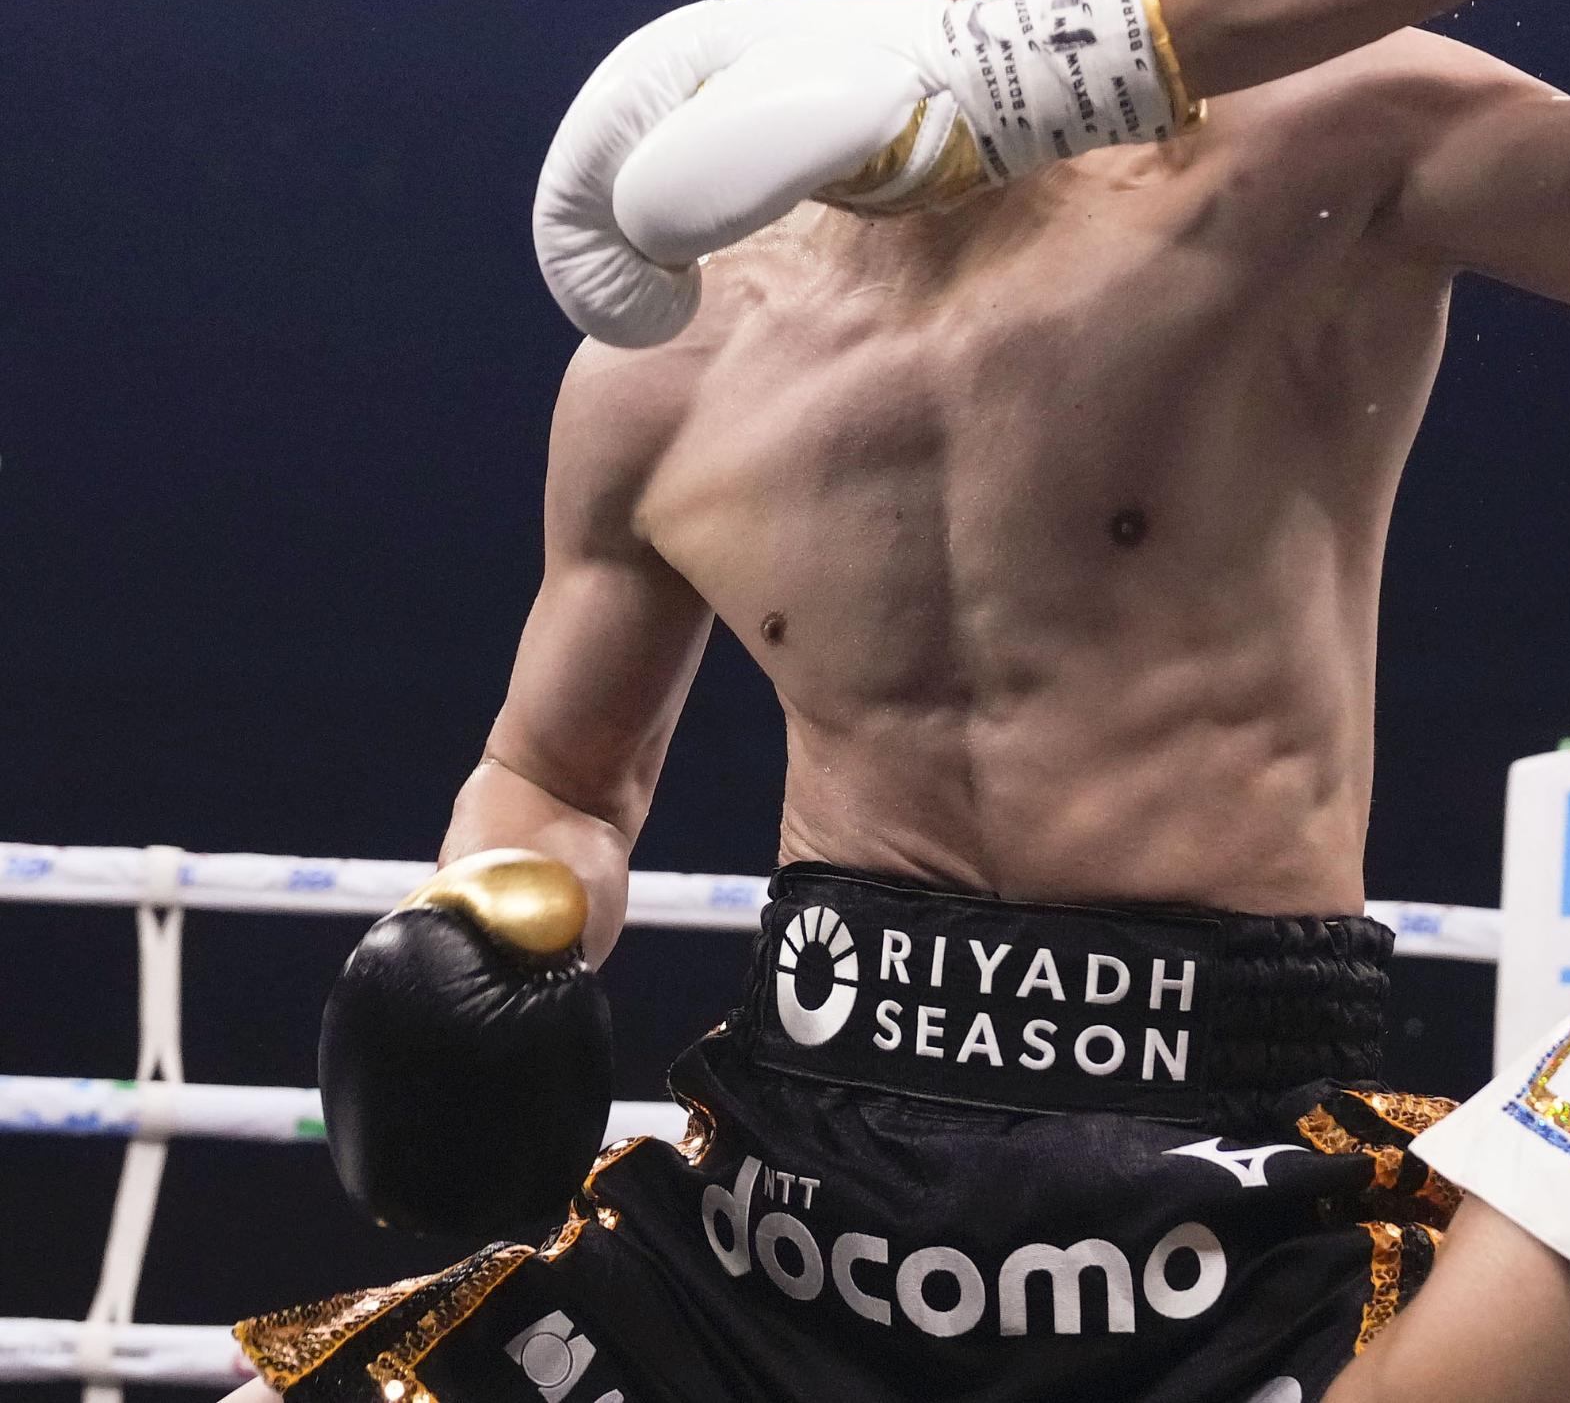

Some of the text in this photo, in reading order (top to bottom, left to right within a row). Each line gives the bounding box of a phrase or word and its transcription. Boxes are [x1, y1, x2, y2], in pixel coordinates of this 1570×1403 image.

[1000, 39, 1026, 112] BOXRAW
[879, 928, 1196, 1013] RIYADH
[872, 999, 1190, 1082] SEASON
[763, 1166, 821, 1210] NTT
[701, 1154, 1229, 1338] docomo
